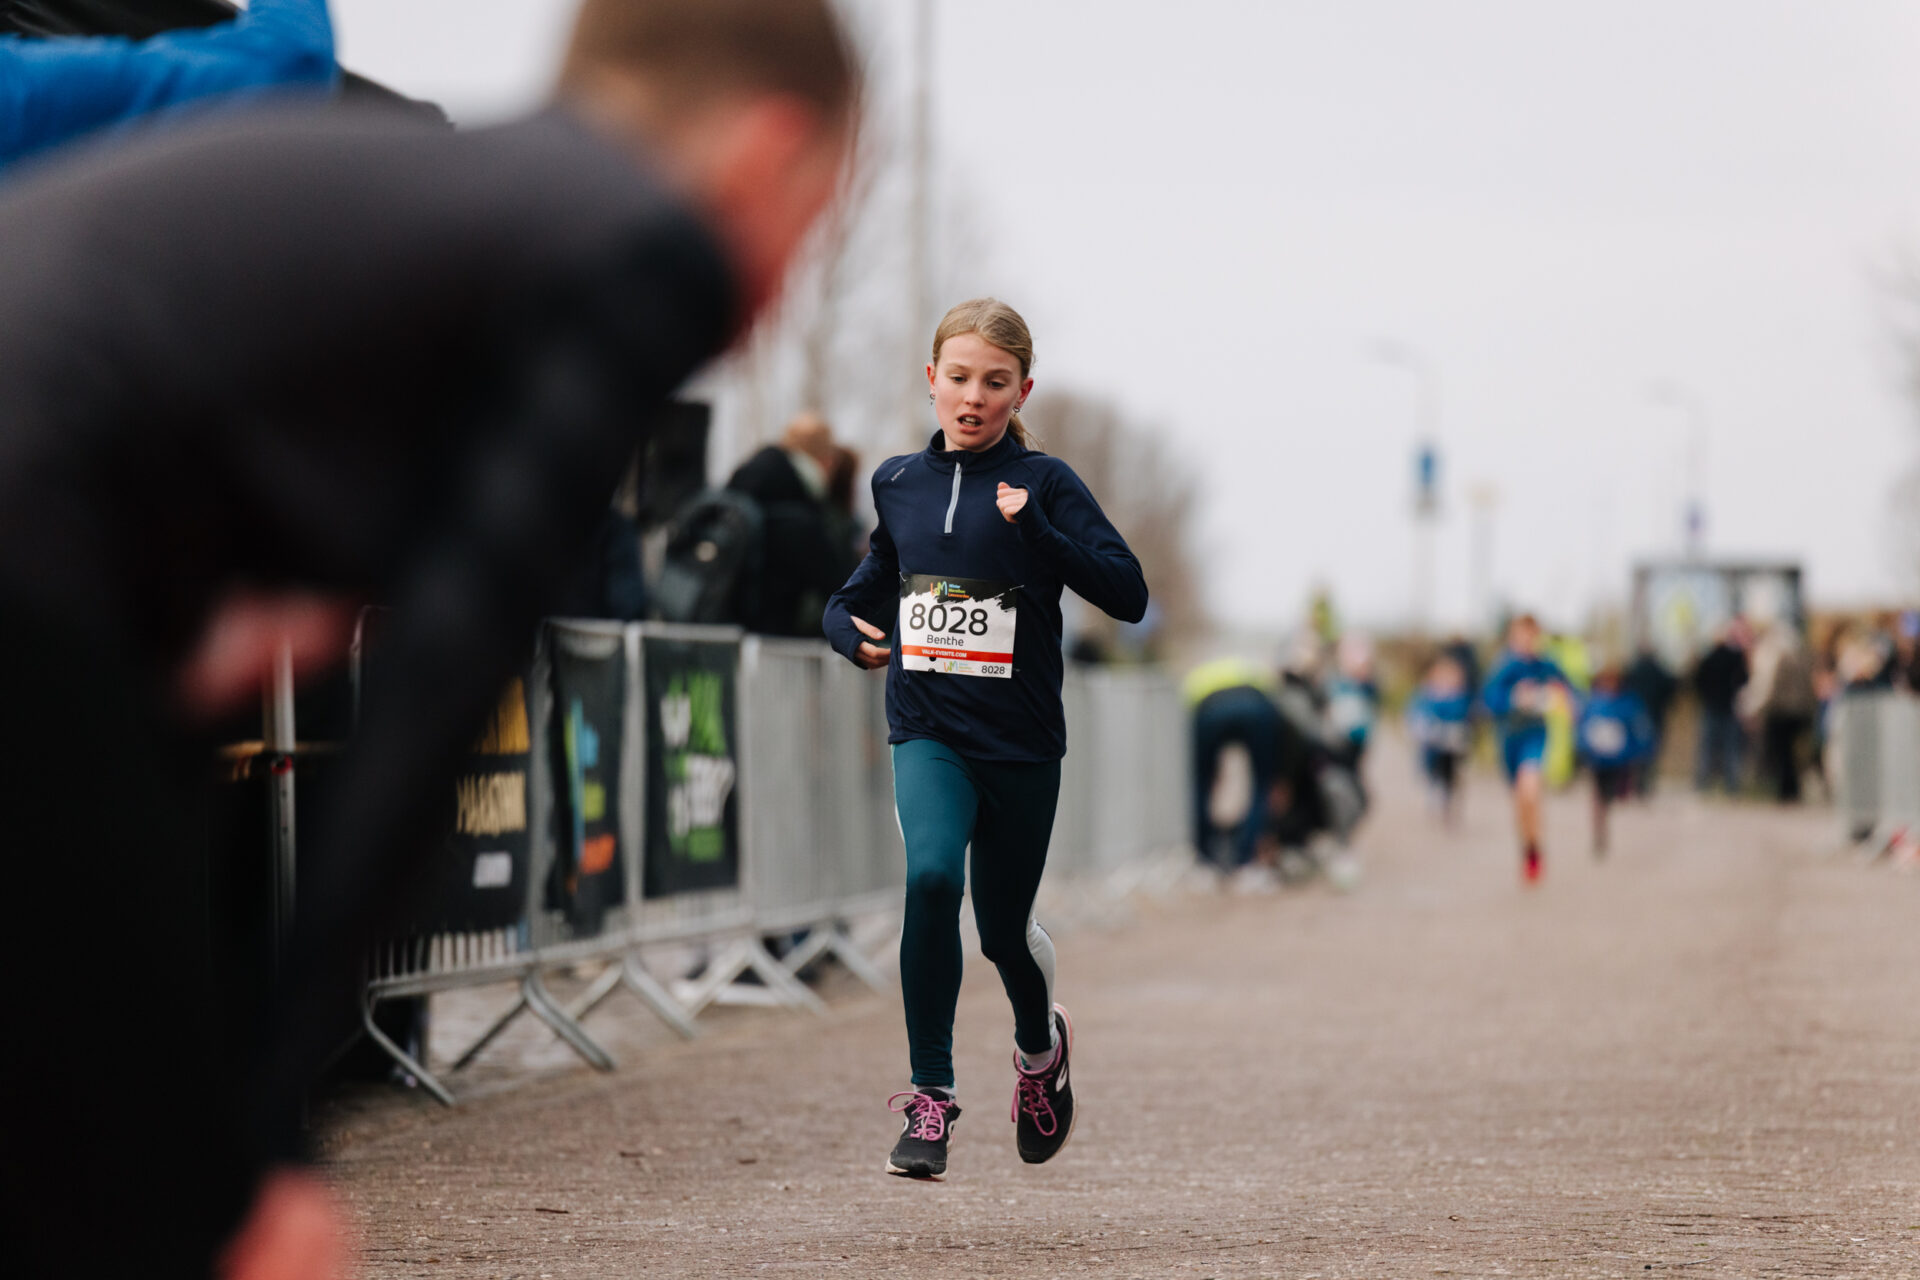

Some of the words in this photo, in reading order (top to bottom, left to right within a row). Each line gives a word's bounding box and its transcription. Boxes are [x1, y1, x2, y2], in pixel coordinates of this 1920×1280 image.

[910, 603, 988, 636] 8028
[926, 634, 965, 647] Benthe
[981, 665, 1006, 675] 8028
